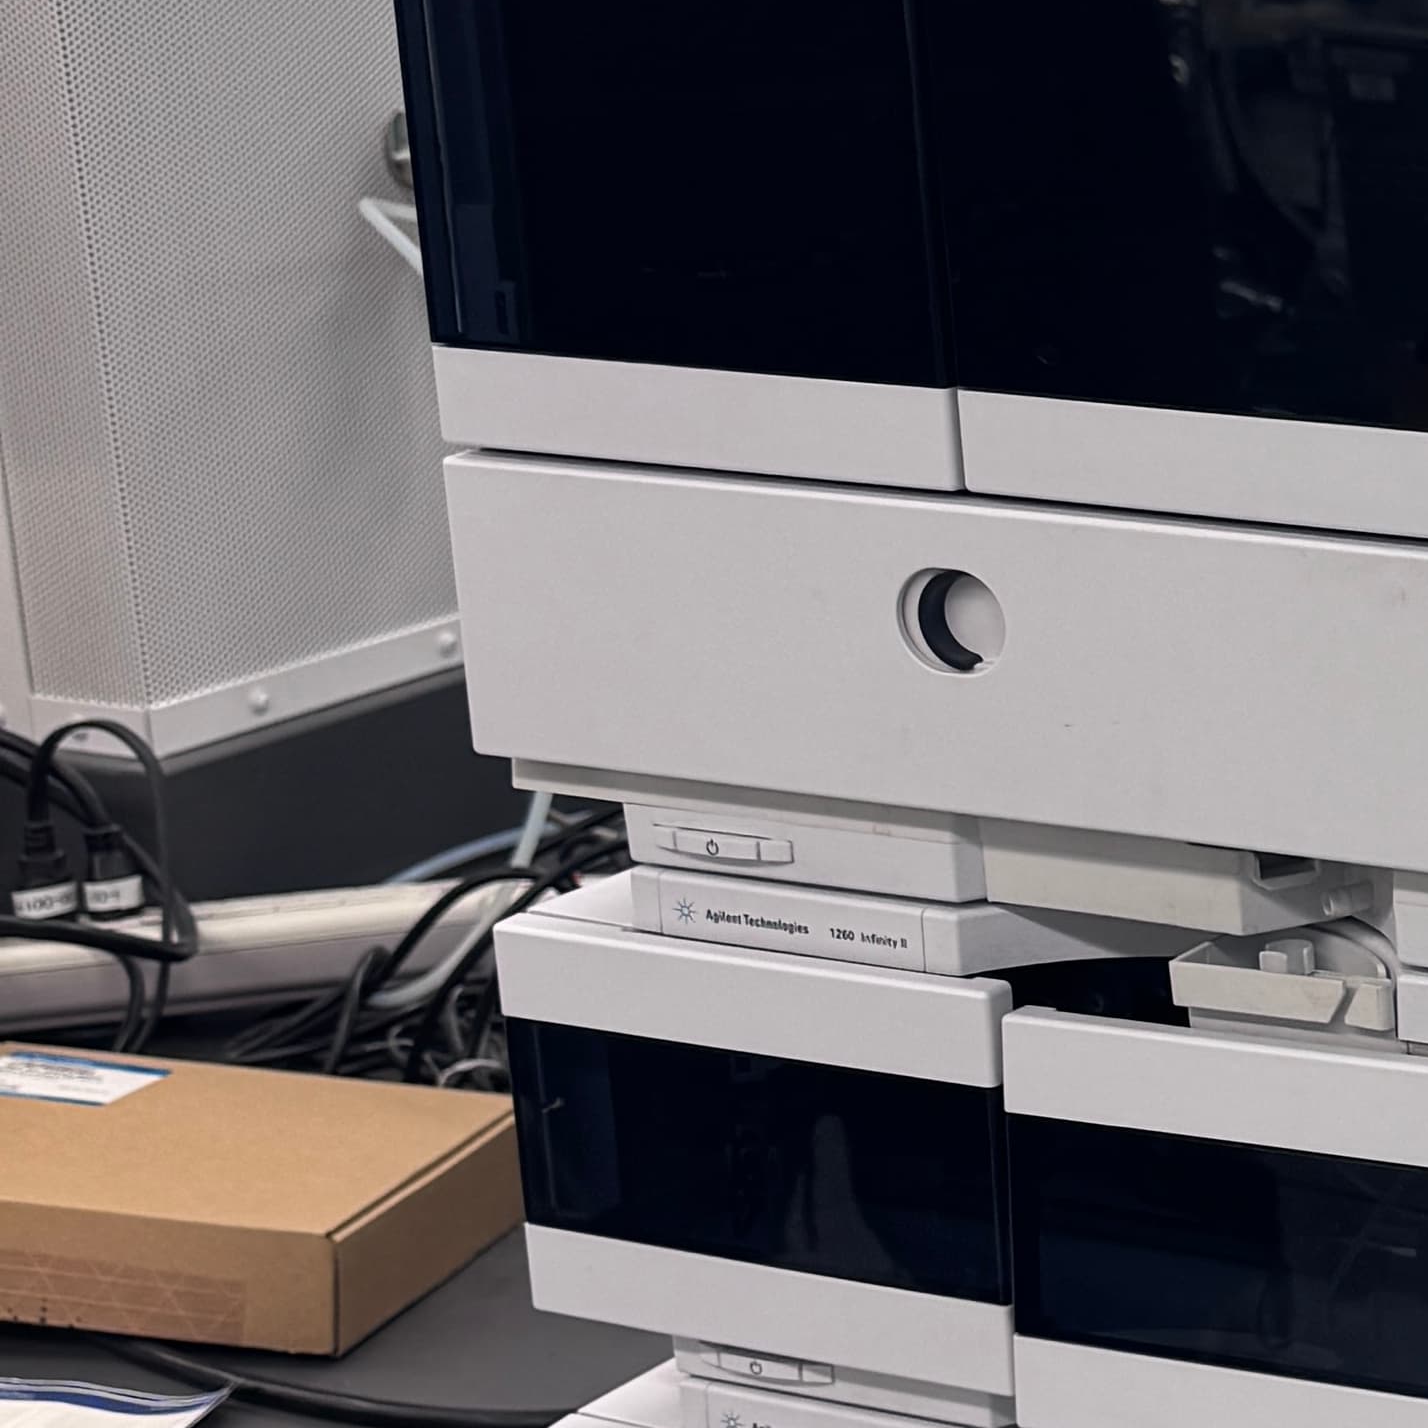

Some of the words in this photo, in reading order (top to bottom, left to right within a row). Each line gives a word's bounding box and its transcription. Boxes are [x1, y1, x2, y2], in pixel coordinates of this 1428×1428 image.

[705, 908, 743, 926] Agilent
[743, 913, 810, 935] Technologies
[829, 927, 855, 942] 1260
[860, 931, 898, 950] Infinity
